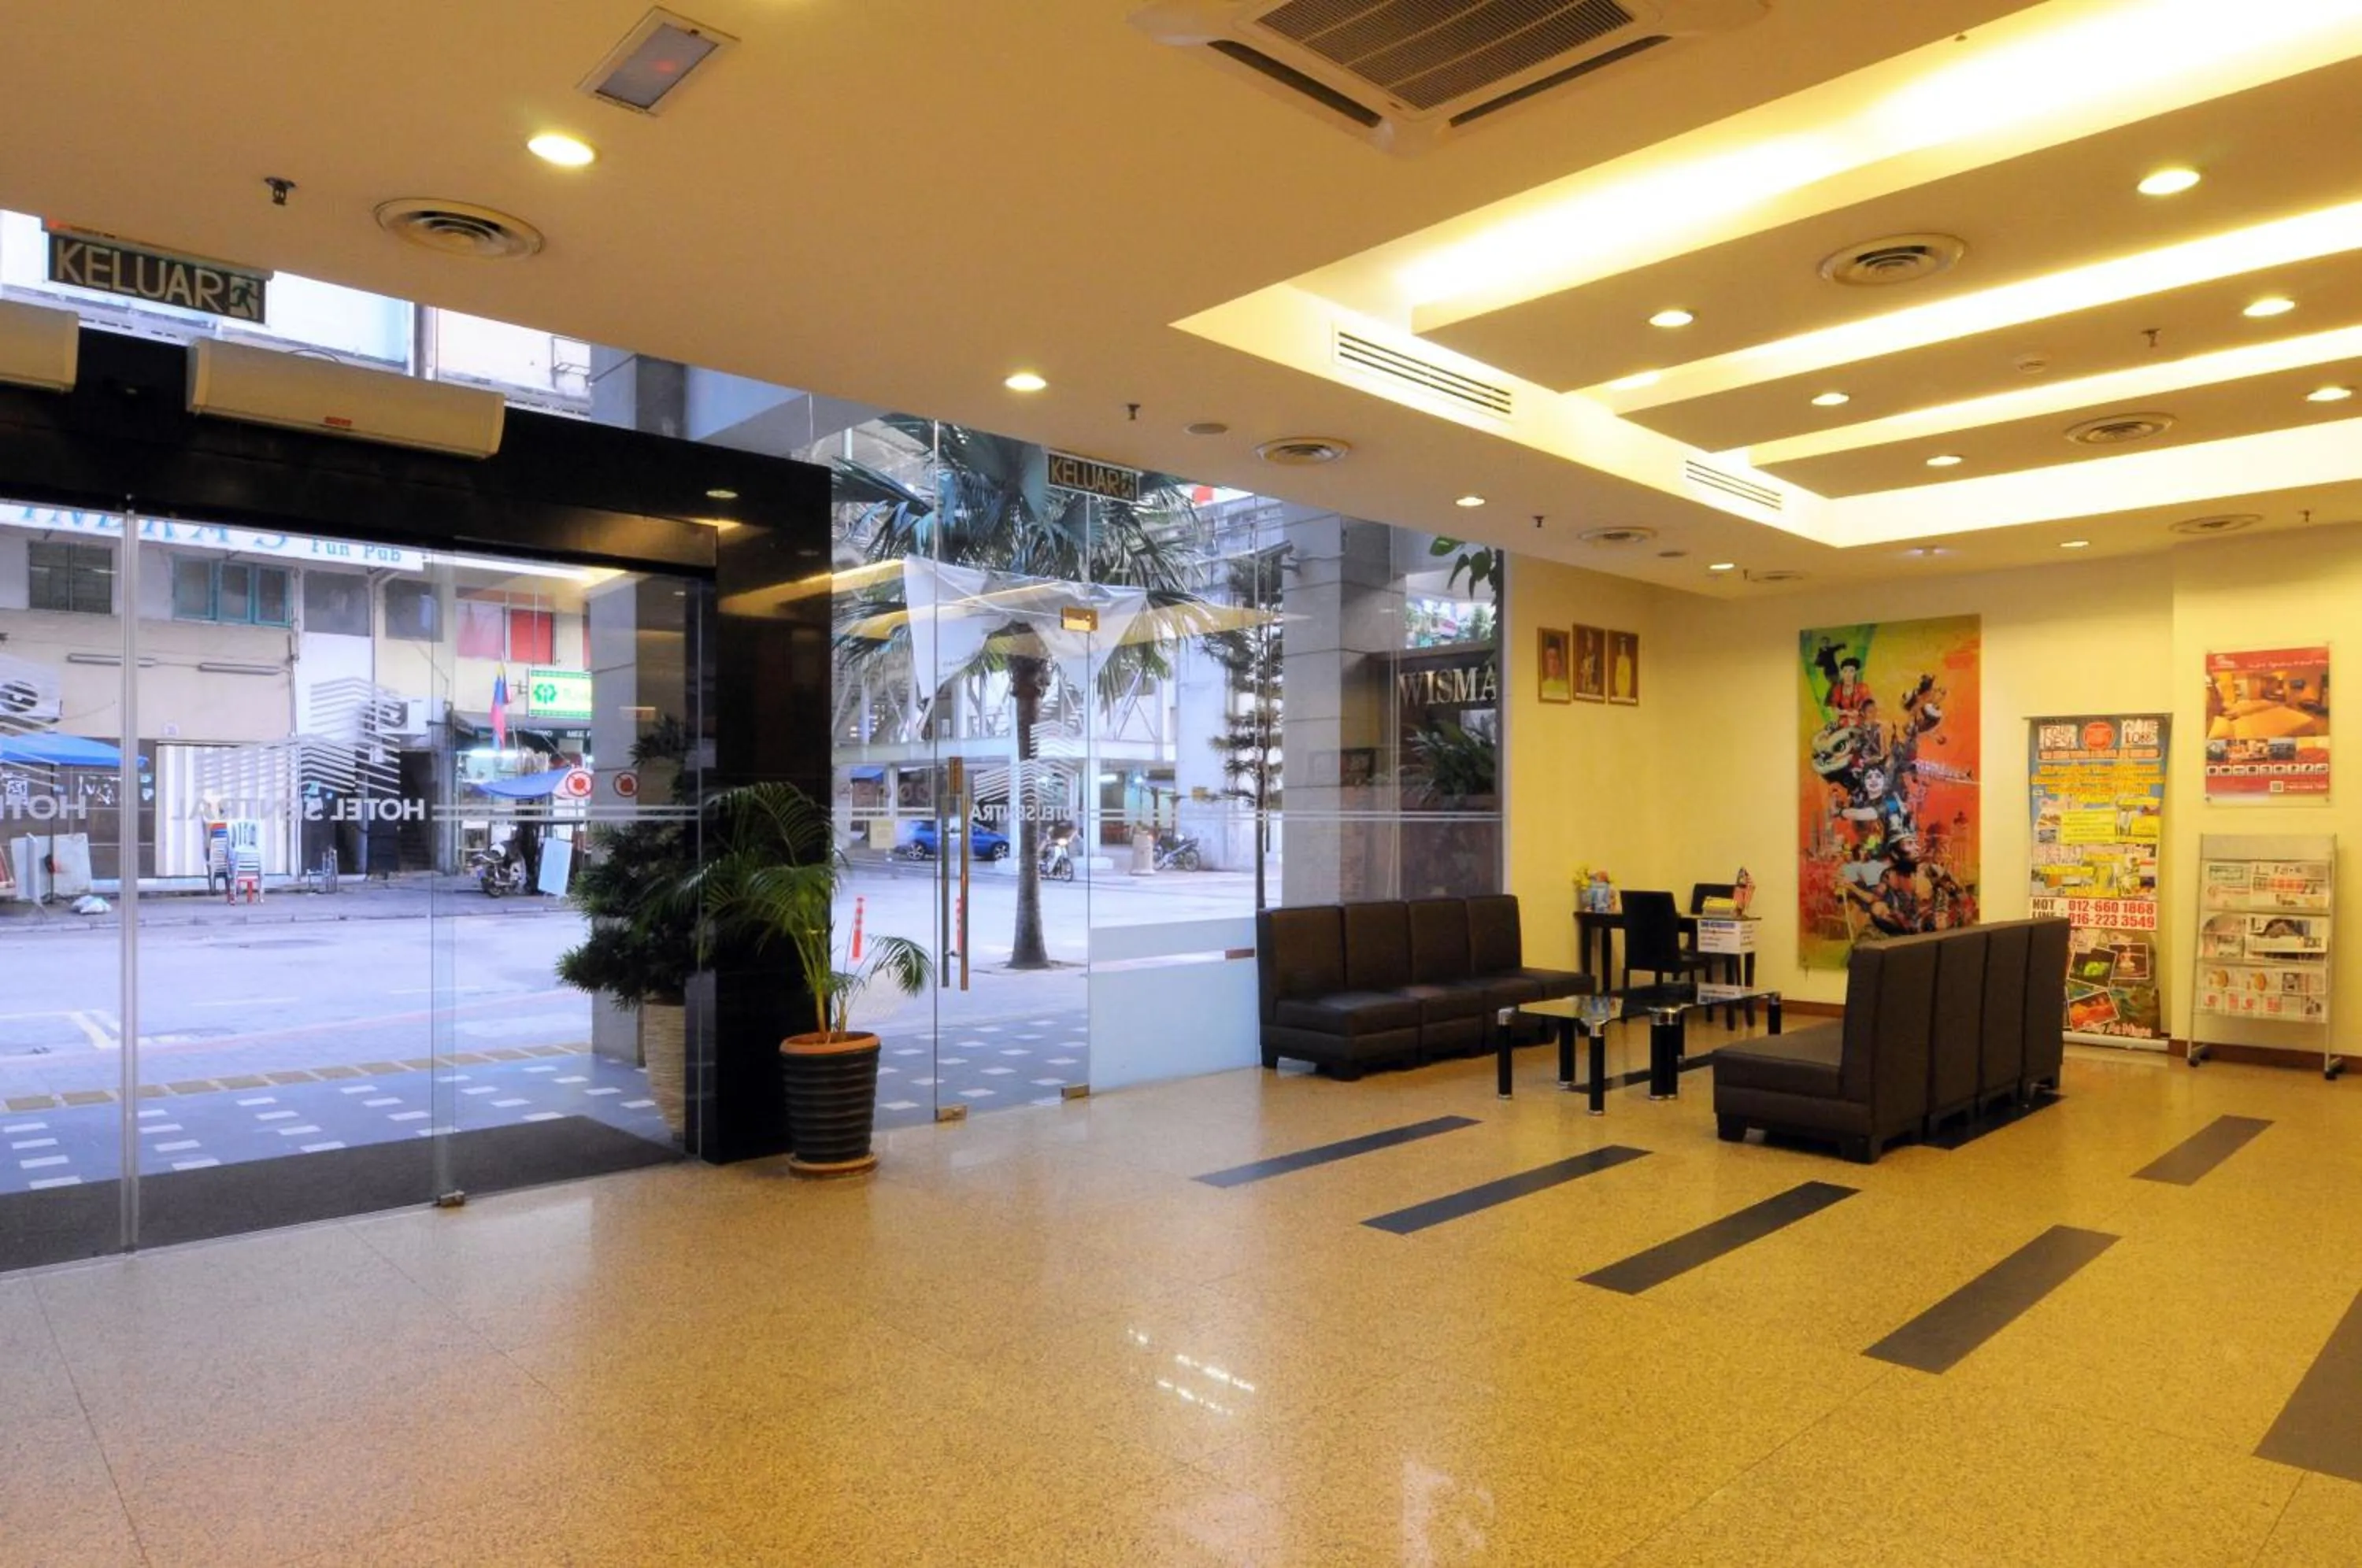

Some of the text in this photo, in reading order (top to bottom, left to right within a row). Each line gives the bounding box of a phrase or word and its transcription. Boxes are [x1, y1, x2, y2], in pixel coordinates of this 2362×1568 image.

[56, 239, 224, 313] KELUAR
[1050, 457, 1120, 495] KELUAR
[363, 543, 402, 562] Pub
[1398, 665, 1497, 707] WISMA
[2120, 915, 2155, 929] 3549
